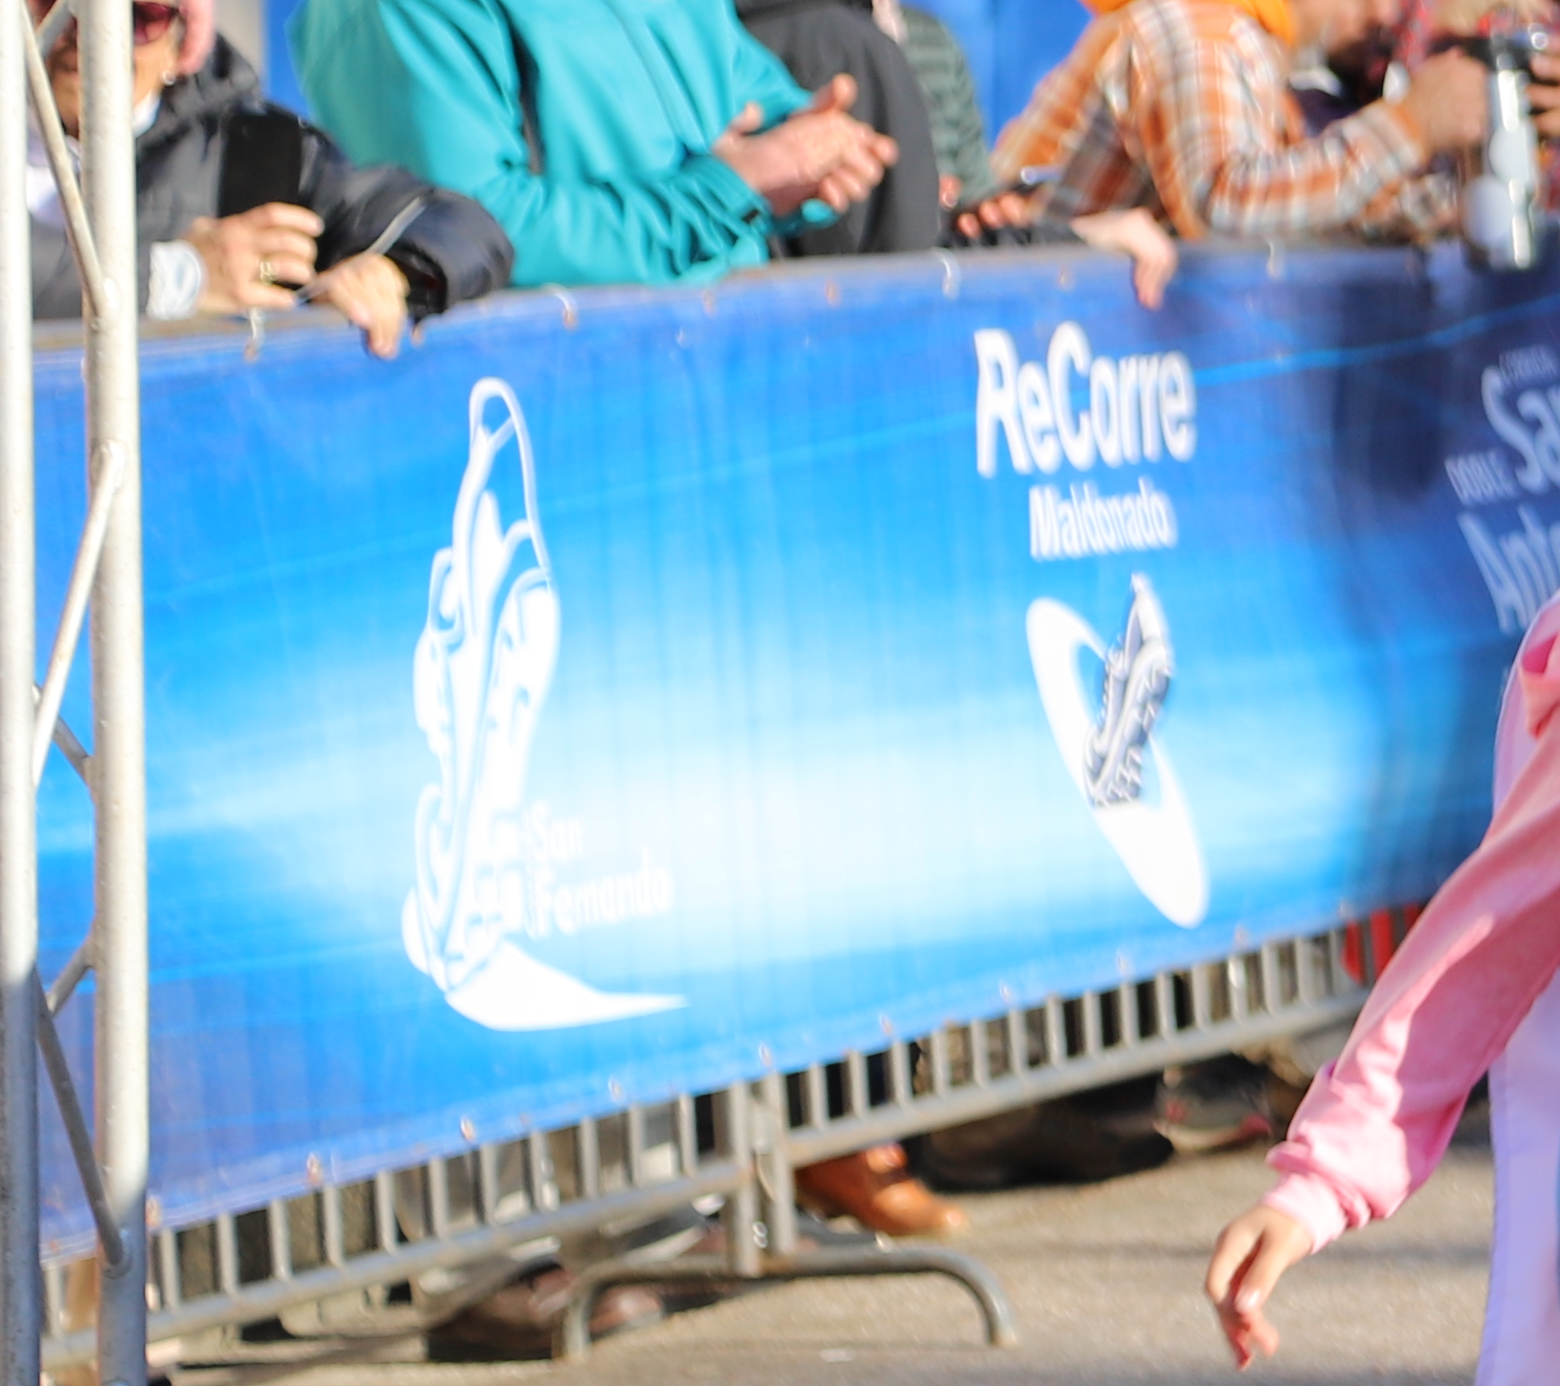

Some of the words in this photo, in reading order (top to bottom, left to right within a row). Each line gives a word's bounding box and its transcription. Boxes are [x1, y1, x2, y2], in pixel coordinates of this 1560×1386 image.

[974, 320, 1197, 479] ReCorre
[1029, 476, 1178, 563] Maldonado
[528, 799, 584, 864] San
[528, 844, 675, 937] Fernando
